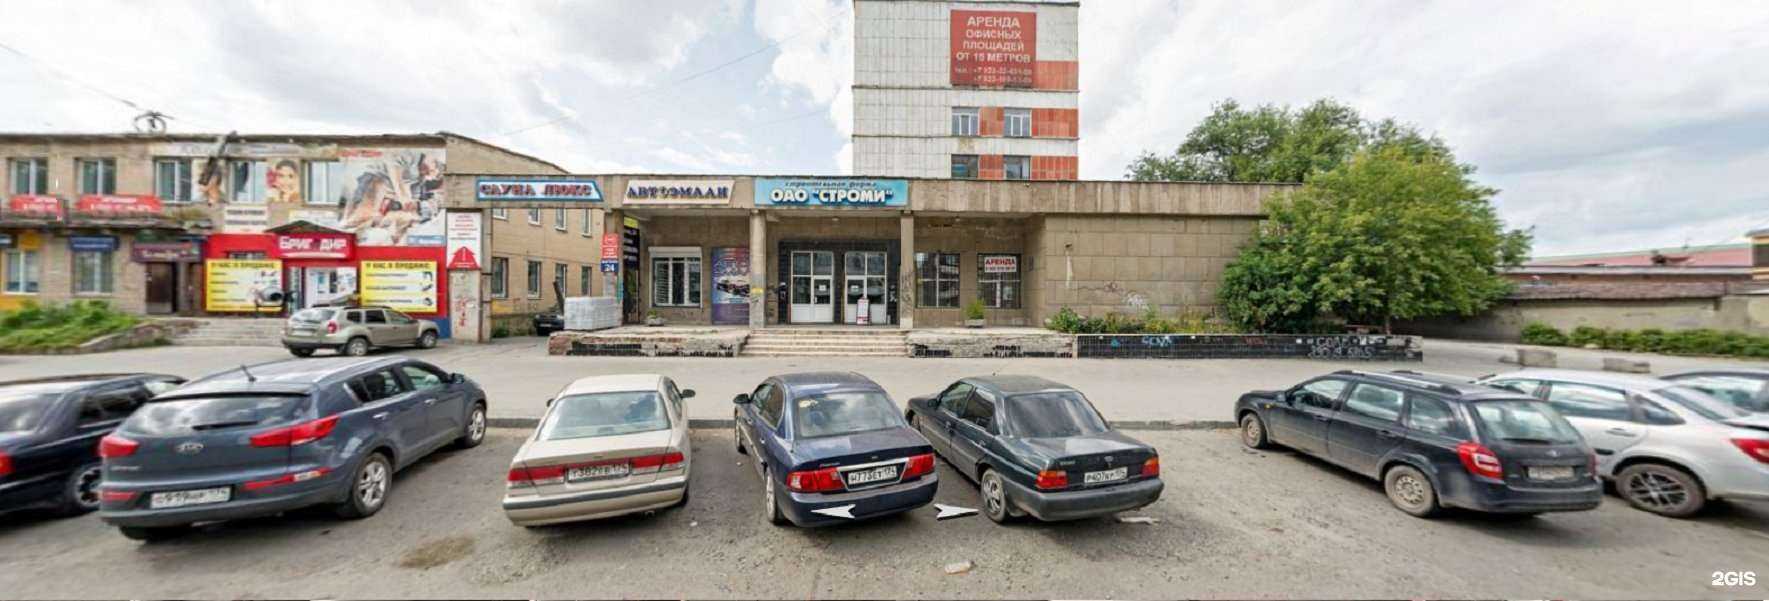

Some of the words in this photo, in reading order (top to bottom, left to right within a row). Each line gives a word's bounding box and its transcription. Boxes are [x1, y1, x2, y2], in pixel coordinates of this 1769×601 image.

[967, 16, 1020, 29] АРЕНДА
[966, 29, 1021, 40] ОФИСНЫХ
[963, 40, 1024, 52] ПЛОЩАДЕЙ
[956, 52, 970, 61] ОТ
[987, 53, 1031, 64] МЕТРОВ
[480, 184, 536, 196] САУНА
[543, 184, 592, 196] ЛЮКС
[771, 189, 808, 203] ОАО
[814, 189, 893, 203] "СТРОМИ"
[986, 258, 1015, 266] АРЕНДА
